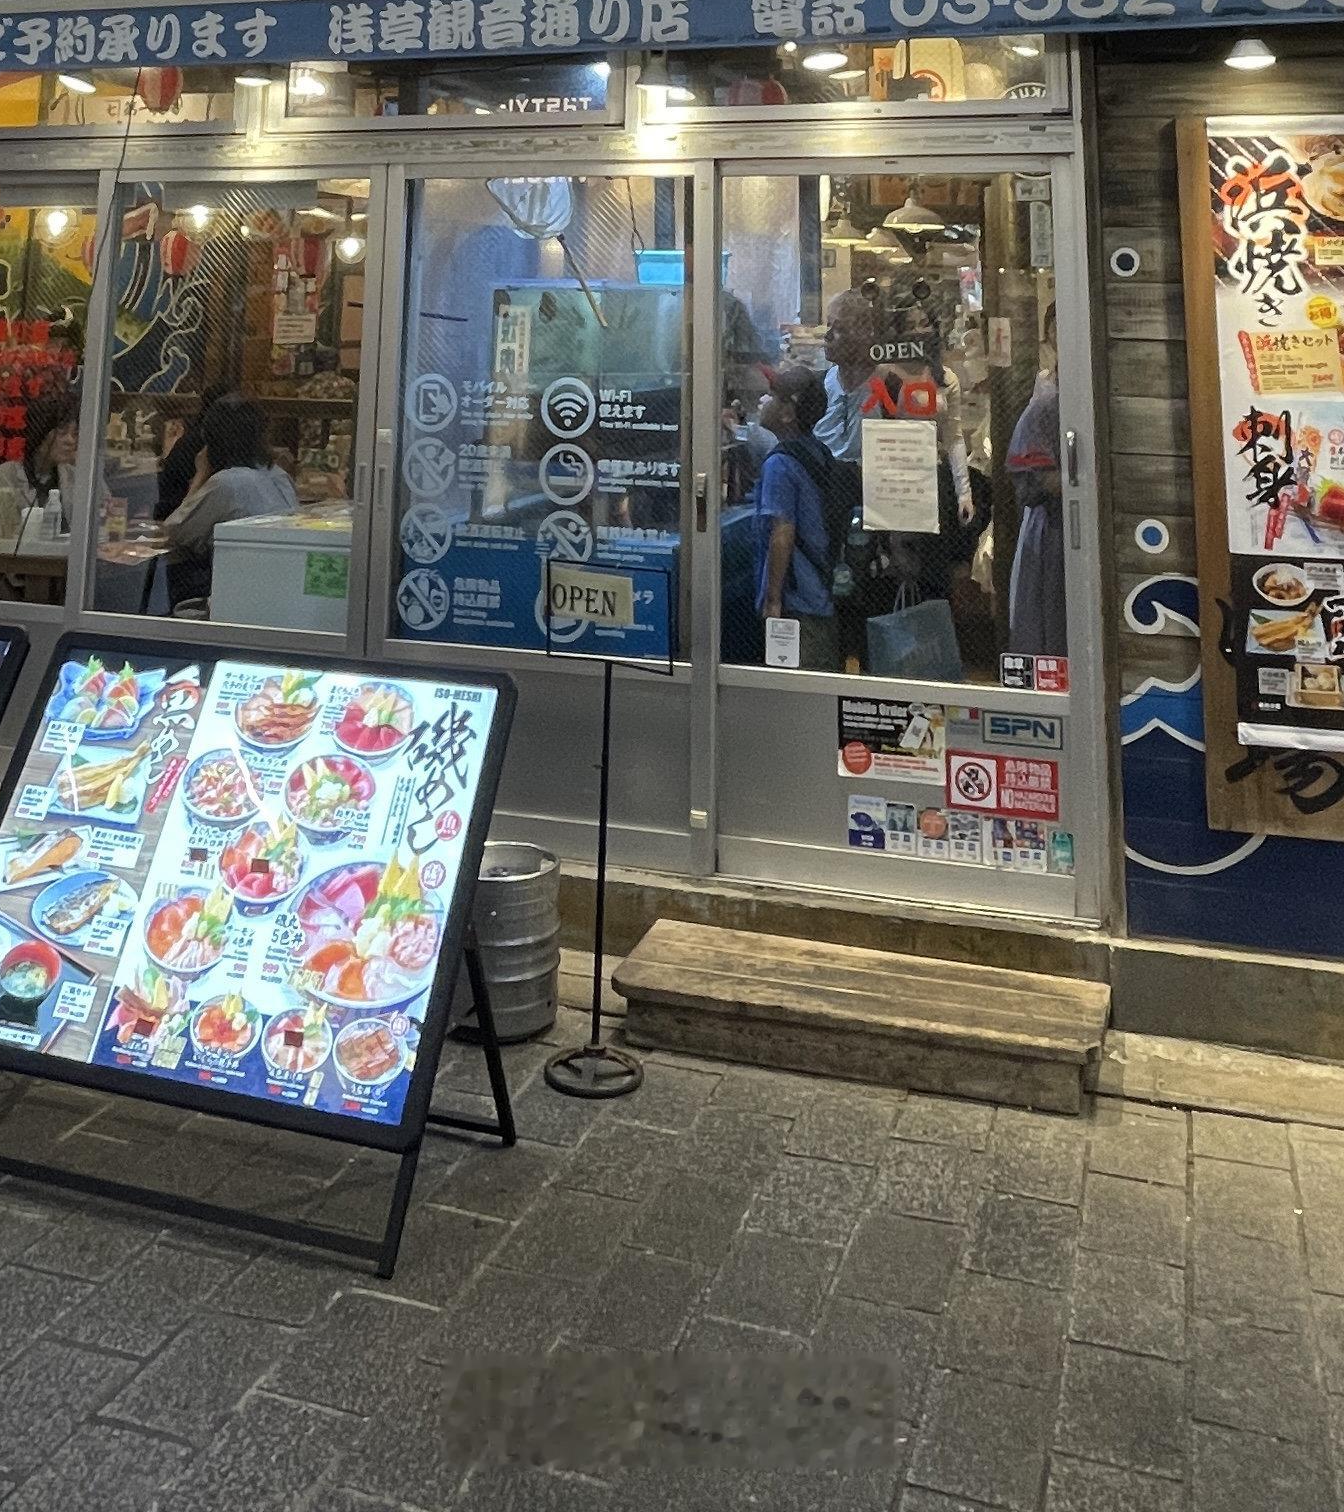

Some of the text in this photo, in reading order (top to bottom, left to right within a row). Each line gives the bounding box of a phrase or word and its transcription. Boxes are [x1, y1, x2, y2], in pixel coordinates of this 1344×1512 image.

[869, 340, 926, 362] OPEN
[1236, 405, 1298, 509] 刺身
[552, 582, 617, 617] OPEN
[990, 716, 1055, 740] SPN
